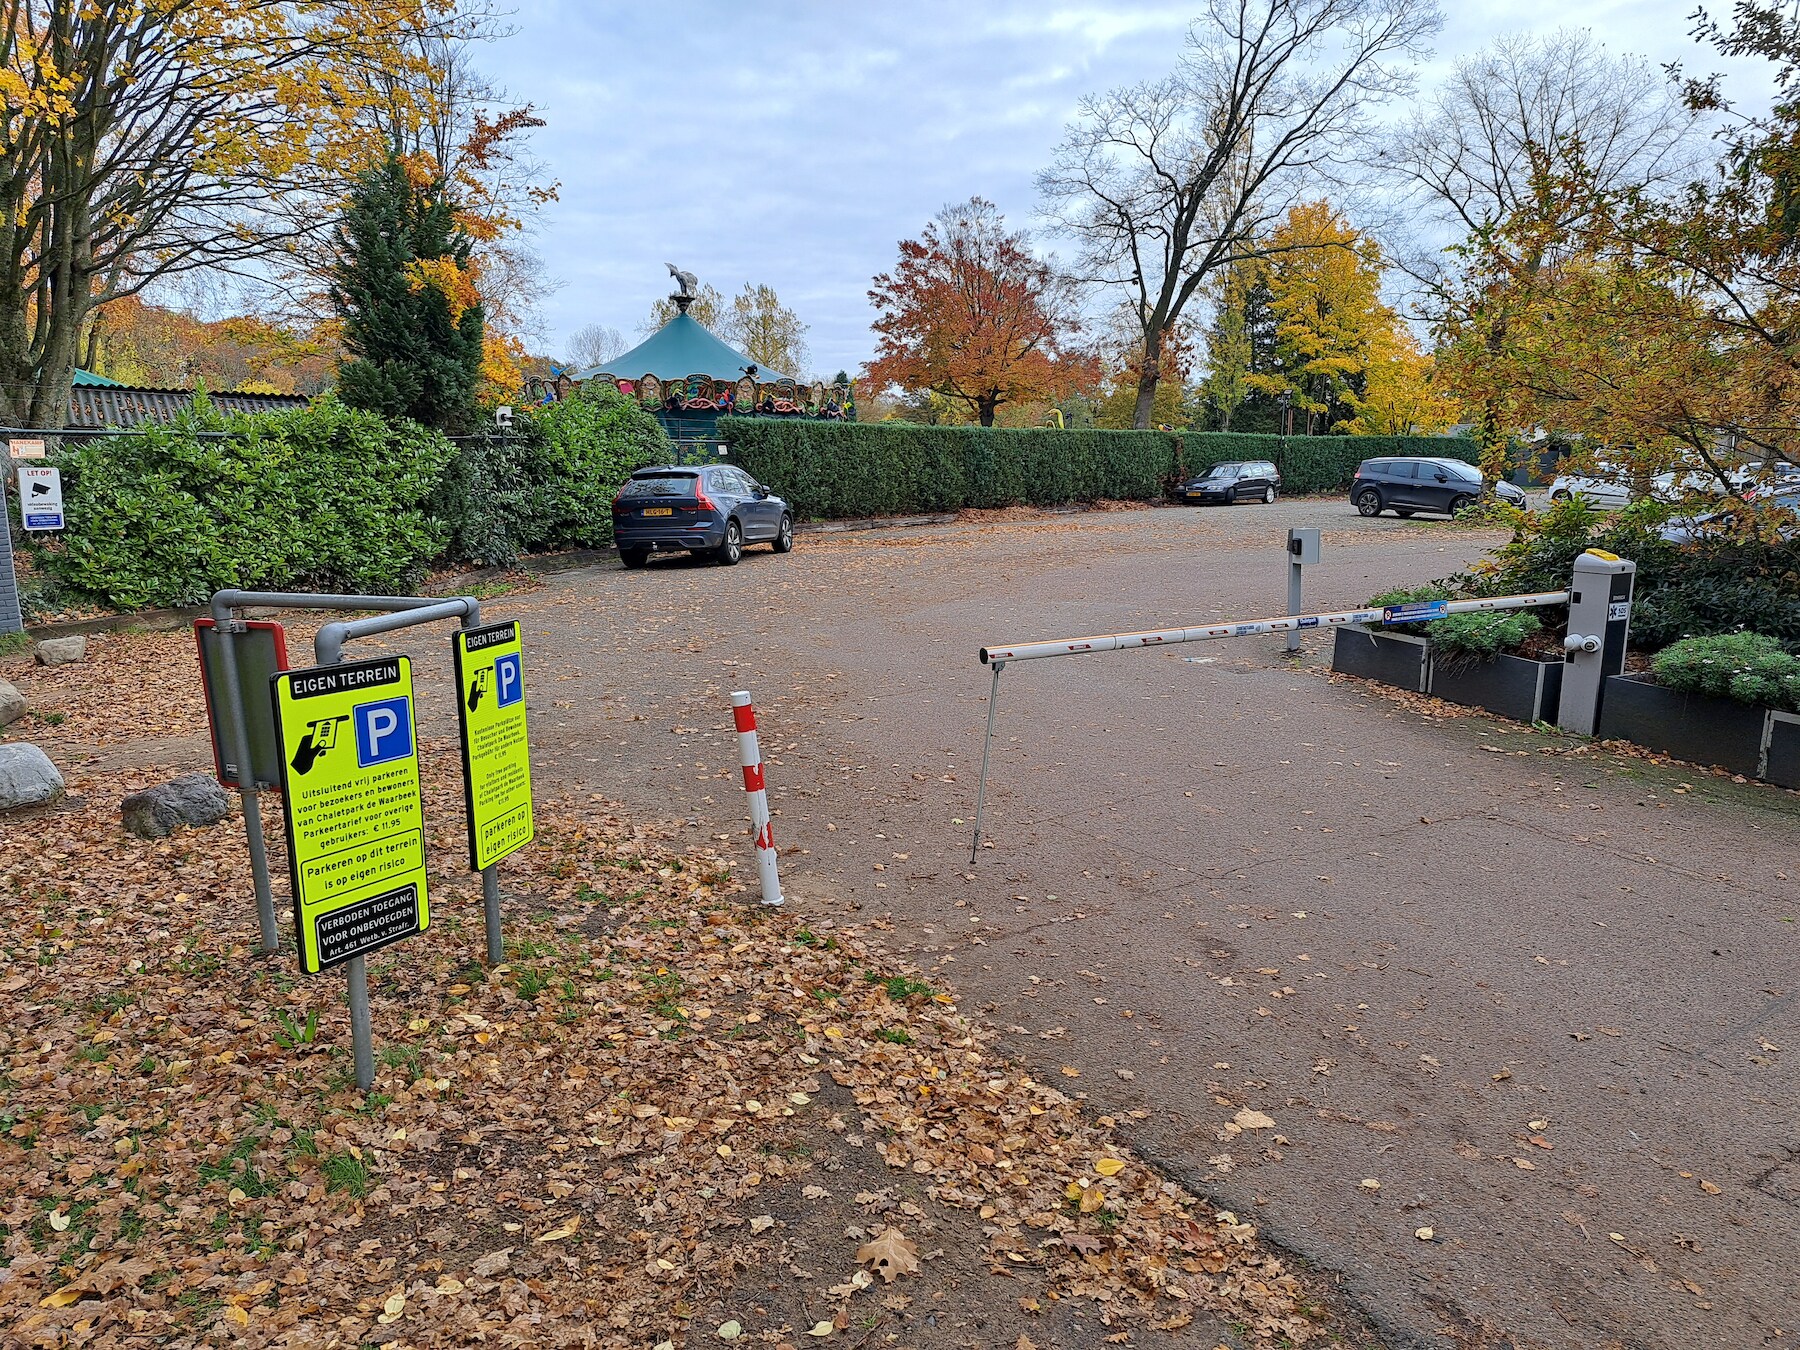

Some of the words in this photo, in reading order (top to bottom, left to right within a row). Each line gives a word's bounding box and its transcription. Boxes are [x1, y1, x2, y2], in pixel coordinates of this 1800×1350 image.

[466, 634, 488, 648] EIGEN
[488, 628, 514, 642] TERREIN
[294, 676, 336, 694] EIGEN
[340, 666, 397, 686] TERREIN
[501, 661, 516, 700] P
[367, 708, 398, 756] P
[477, 739, 498, 751] Chaletpark
[503, 762, 516, 772] parking
[298, 803, 317, 814] voor
[320, 792, 362, 808] bezoekers
[365, 789, 375, 797] en
[377, 779, 414, 794] bewoners
[302, 780, 352, 800] Uitsluitend
[355, 776, 370, 786] vrij
[372, 768, 408, 782] parkeren
[484, 784, 503, 796] Chaletpark
[298, 818, 314, 827] van
[317, 803, 364, 822] Chaletpark
[367, 801, 376, 809] de
[379, 790, 417, 806] Waarbeek
[479, 797, 493, 806] Parking
[304, 816, 362, 839] Parkeertarief
[365, 812, 382, 822] voor
[384, 804, 414, 817] overige
[320, 829, 369, 849] gebruikers:
[382, 818, 401, 830] 11.95
[485, 816, 516, 840] parkeren
[518, 811, 526, 820] op
[486, 838, 506, 854] eigen
[508, 826, 526, 842] risico
[307, 858, 354, 878] Parkeren
[356, 854, 367, 863] op
[370, 847, 383, 858] dit
[386, 838, 418, 854] terrein
[324, 880, 333, 889] is
[336, 876, 348, 886] op
[351, 867, 377, 880] eigen
[380, 858, 406, 872] risico
[321, 907, 370, 932] VERBODEN
[372, 892, 413, 914] TOEGANG
[322, 930, 348, 946] VOOR
[350, 906, 413, 936] ONBEVOEGDEN
[329, 946, 343, 957] Art.
[345, 941, 357, 950] 461
[360, 932, 380, 945] Wetb.
[388, 921, 410, 934] Strafr.
